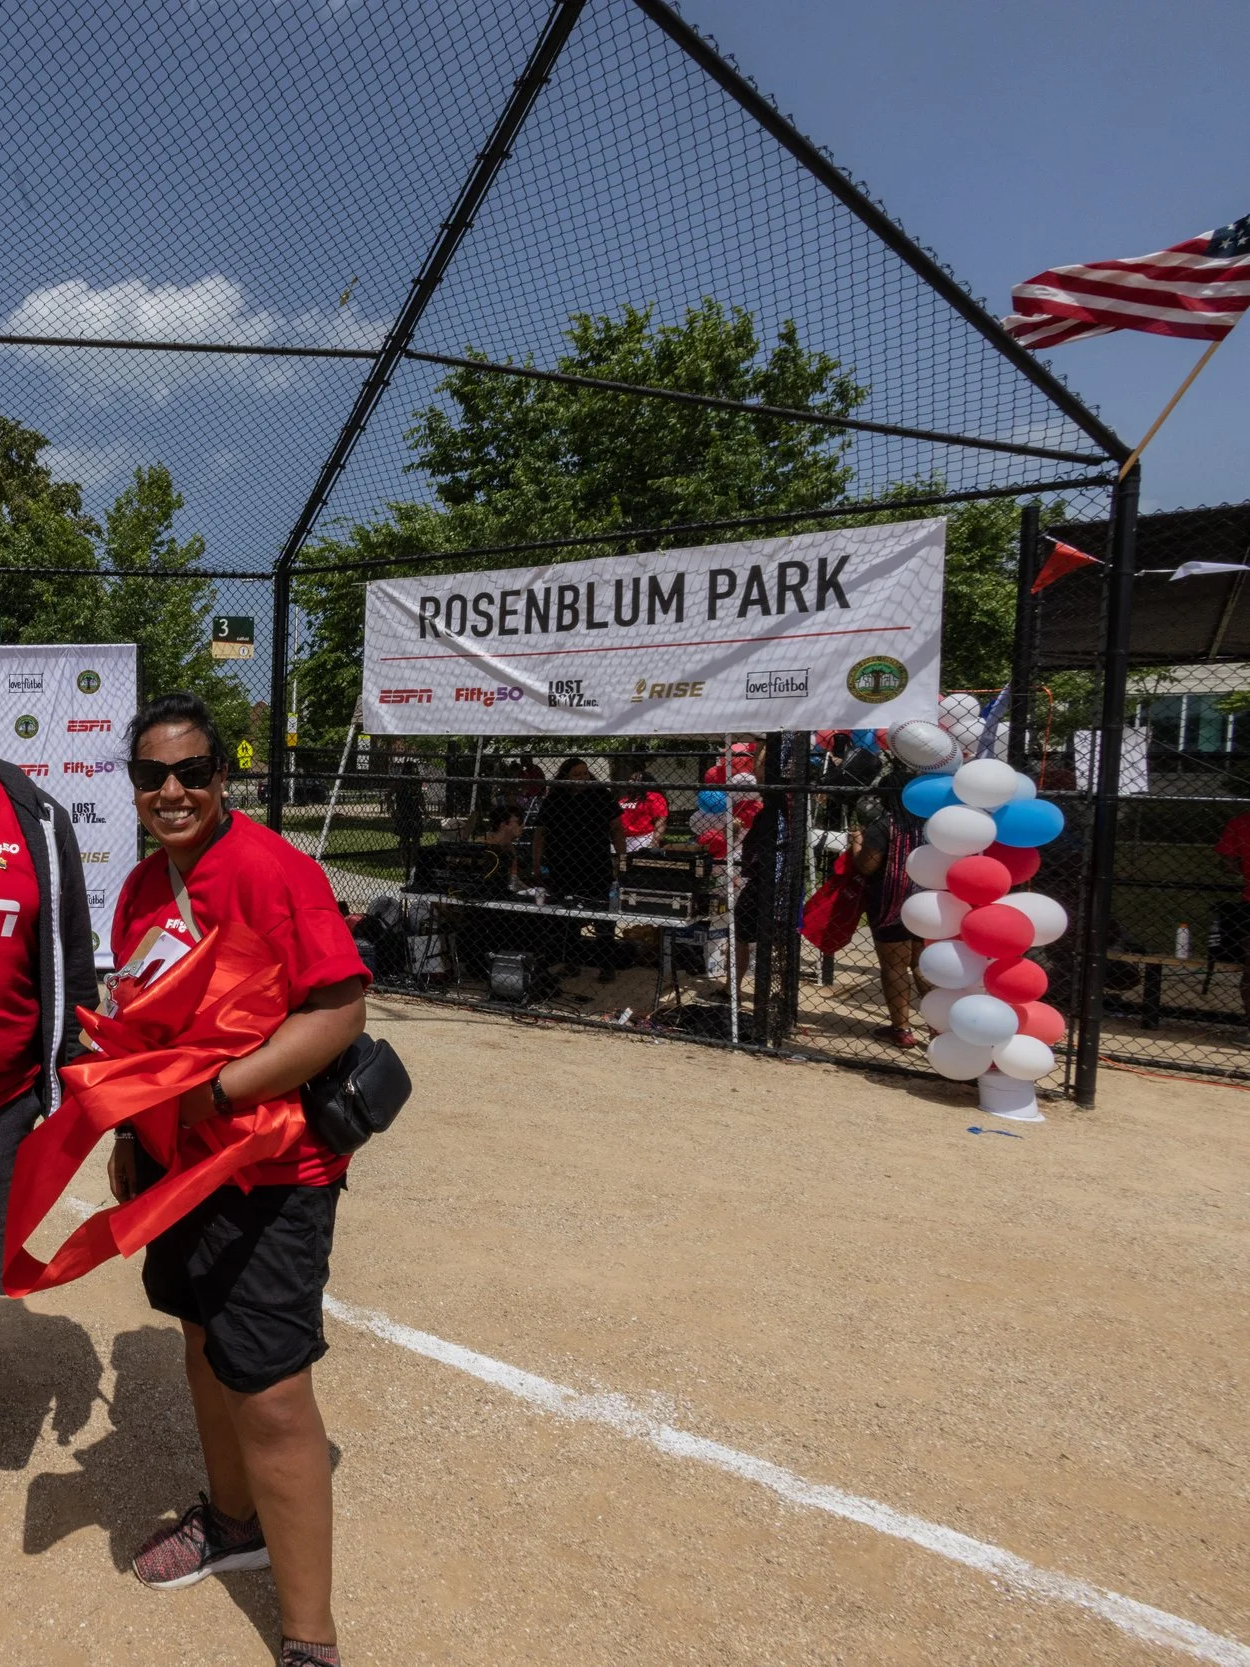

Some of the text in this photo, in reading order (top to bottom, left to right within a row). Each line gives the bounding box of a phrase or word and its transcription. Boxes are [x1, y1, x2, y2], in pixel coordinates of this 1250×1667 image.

[419, 554, 851, 639] ROSENBLUM PARK
[218, 618, 229, 637] 3
[9, 679, 22, 689] love
[549, 680, 583, 694] LOST
[649, 681, 706, 699] RISE
[746, 679, 768, 693] love
[379, 688, 433, 704] ESPN
[455, 687, 524, 707] Fifty50
[67, 720, 111, 732] ESPN
[63, 761, 115, 777] Fifty50
[72, 803, 95, 814] LOST
